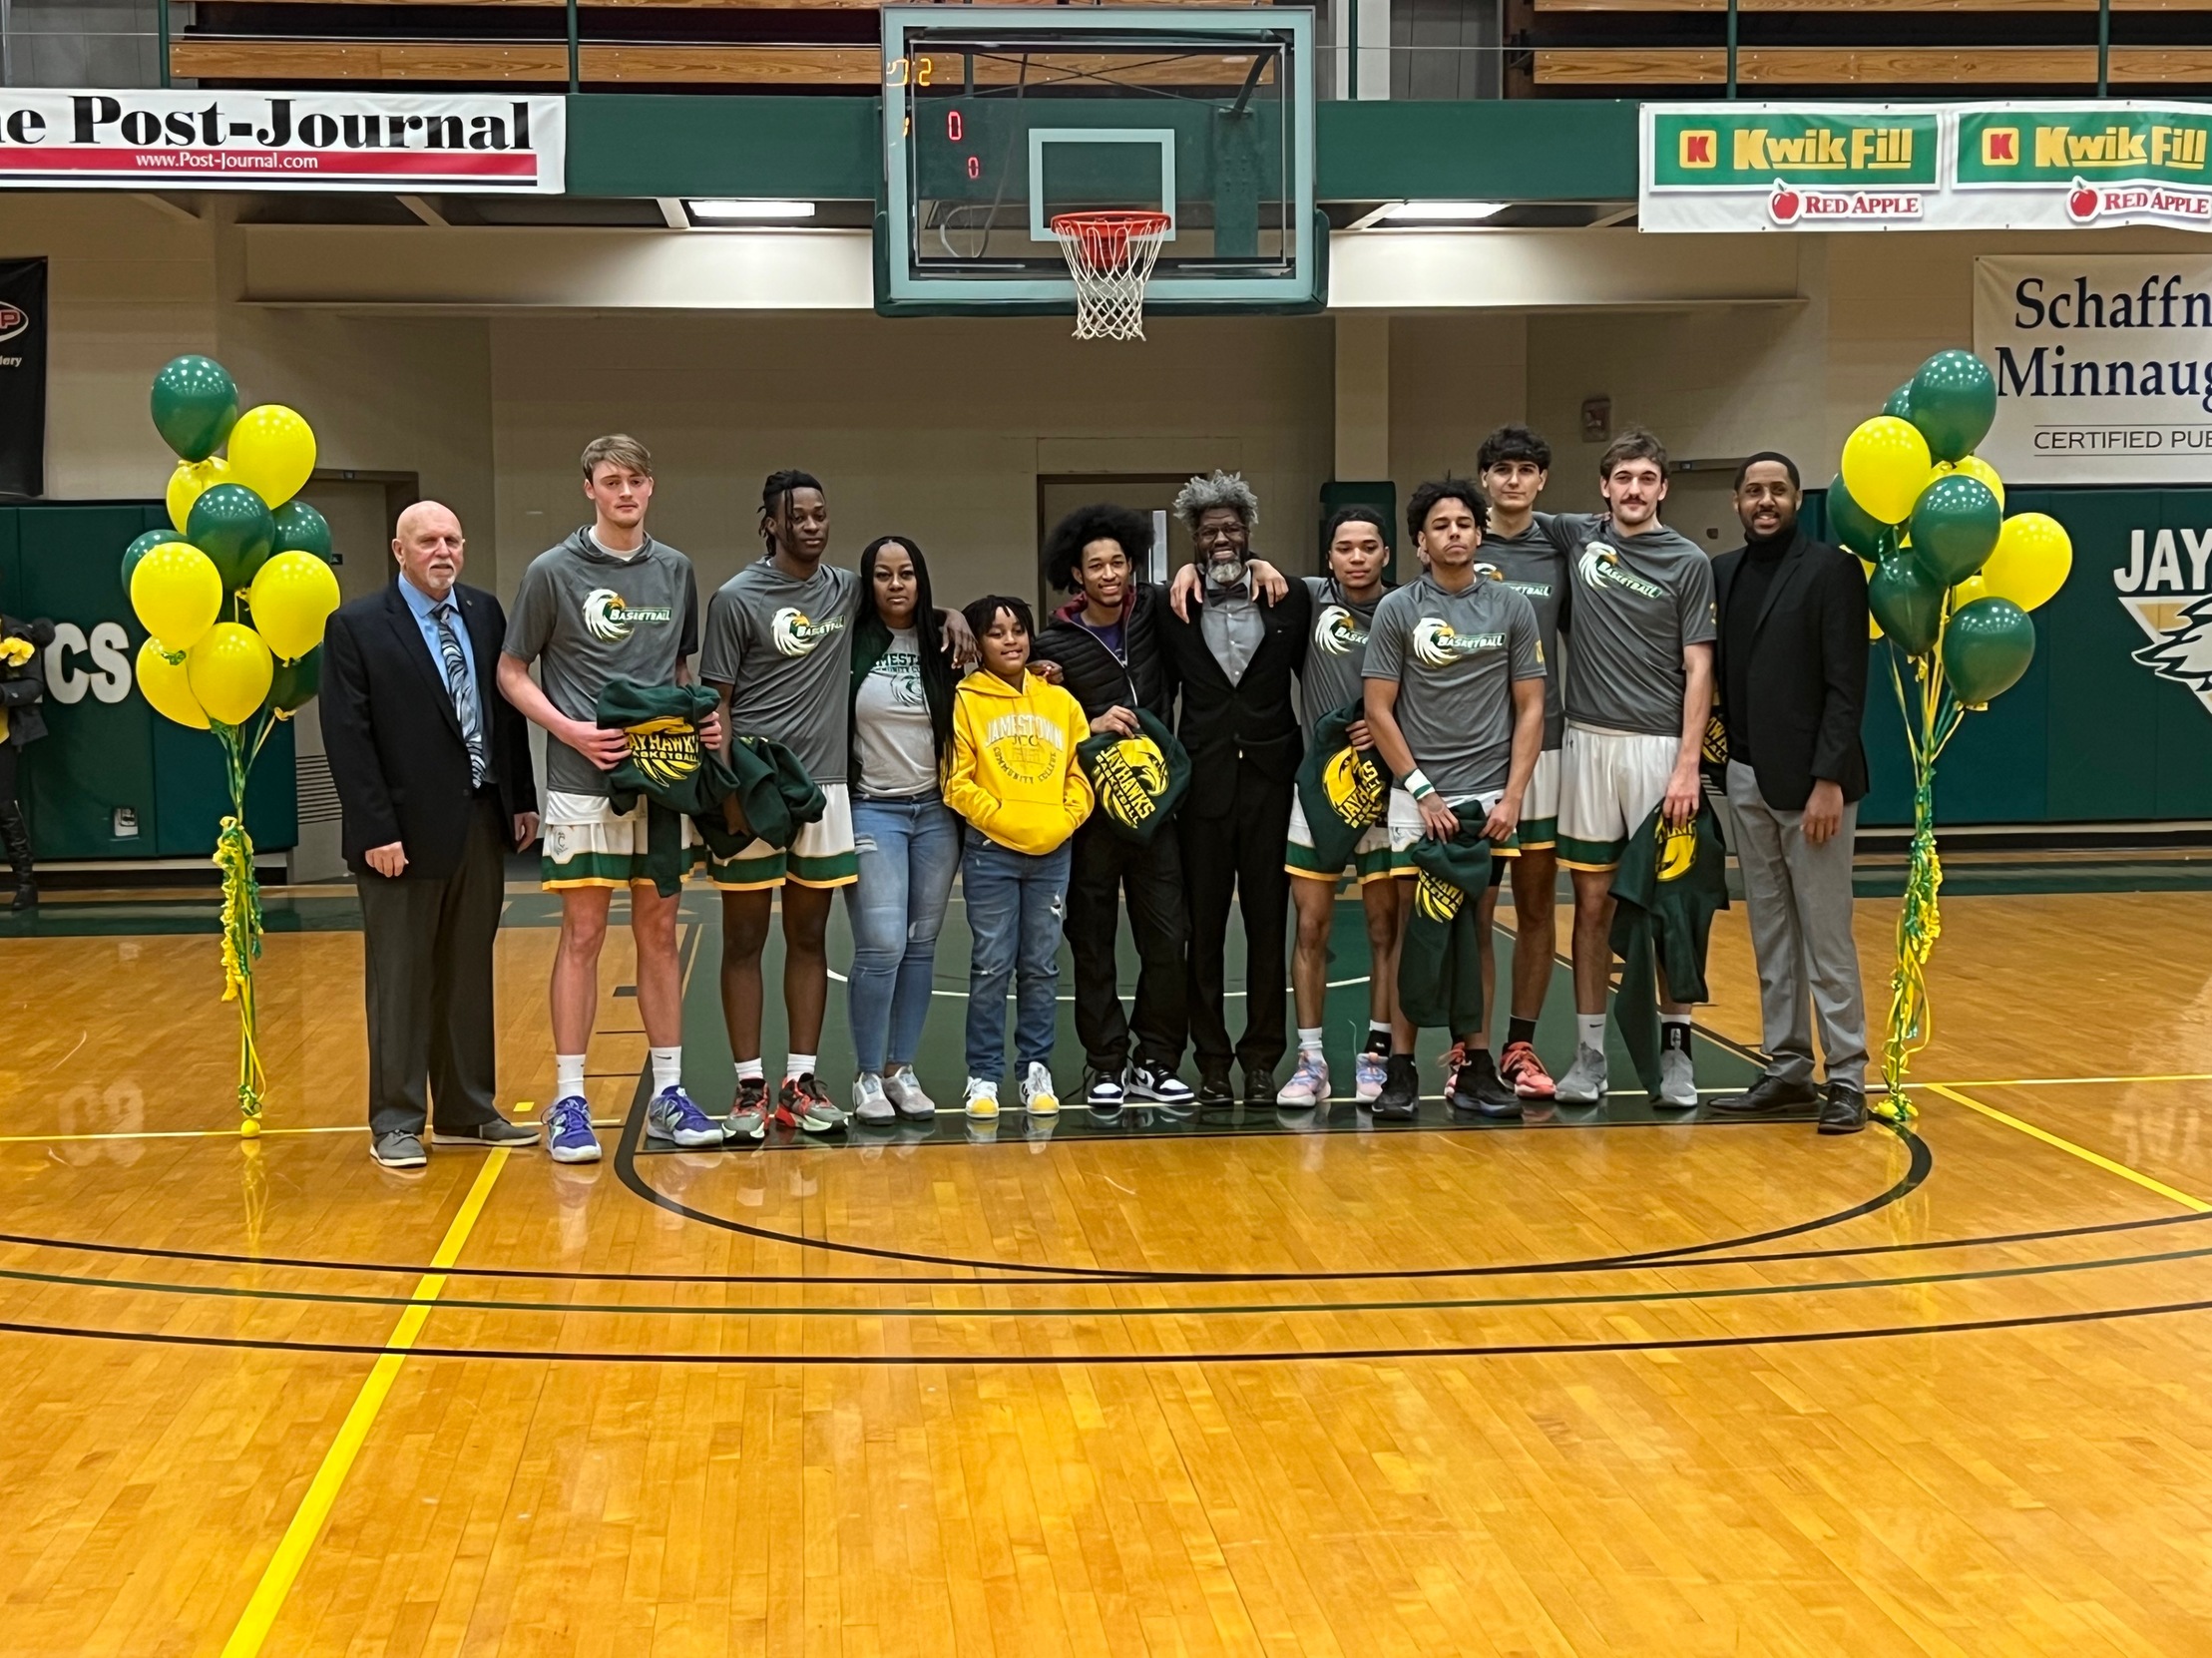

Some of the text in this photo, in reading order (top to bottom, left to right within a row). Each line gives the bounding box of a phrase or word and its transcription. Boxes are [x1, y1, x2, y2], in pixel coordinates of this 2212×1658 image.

[0, 95, 534, 150] e Post-Journal
[136, 152, 318, 170] www.Post-Journal.com
[1733, 129, 1846, 170] Kwik
[1851, 129, 1913, 170] Fill
[2035, 127, 2147, 168] Kwik
[2151, 126, 2207, 170] Fill
[1805, 196, 1920, 213] RED APPLE
[2104, 192, 2209, 214] RED APPLE
[2015, 274, 2212, 329] Schaffn
[2033, 431, 2163, 449] CERTIFIED
[34, 622, 132, 704] CS
[1100, 746, 1155, 819] JAYHAWKS
